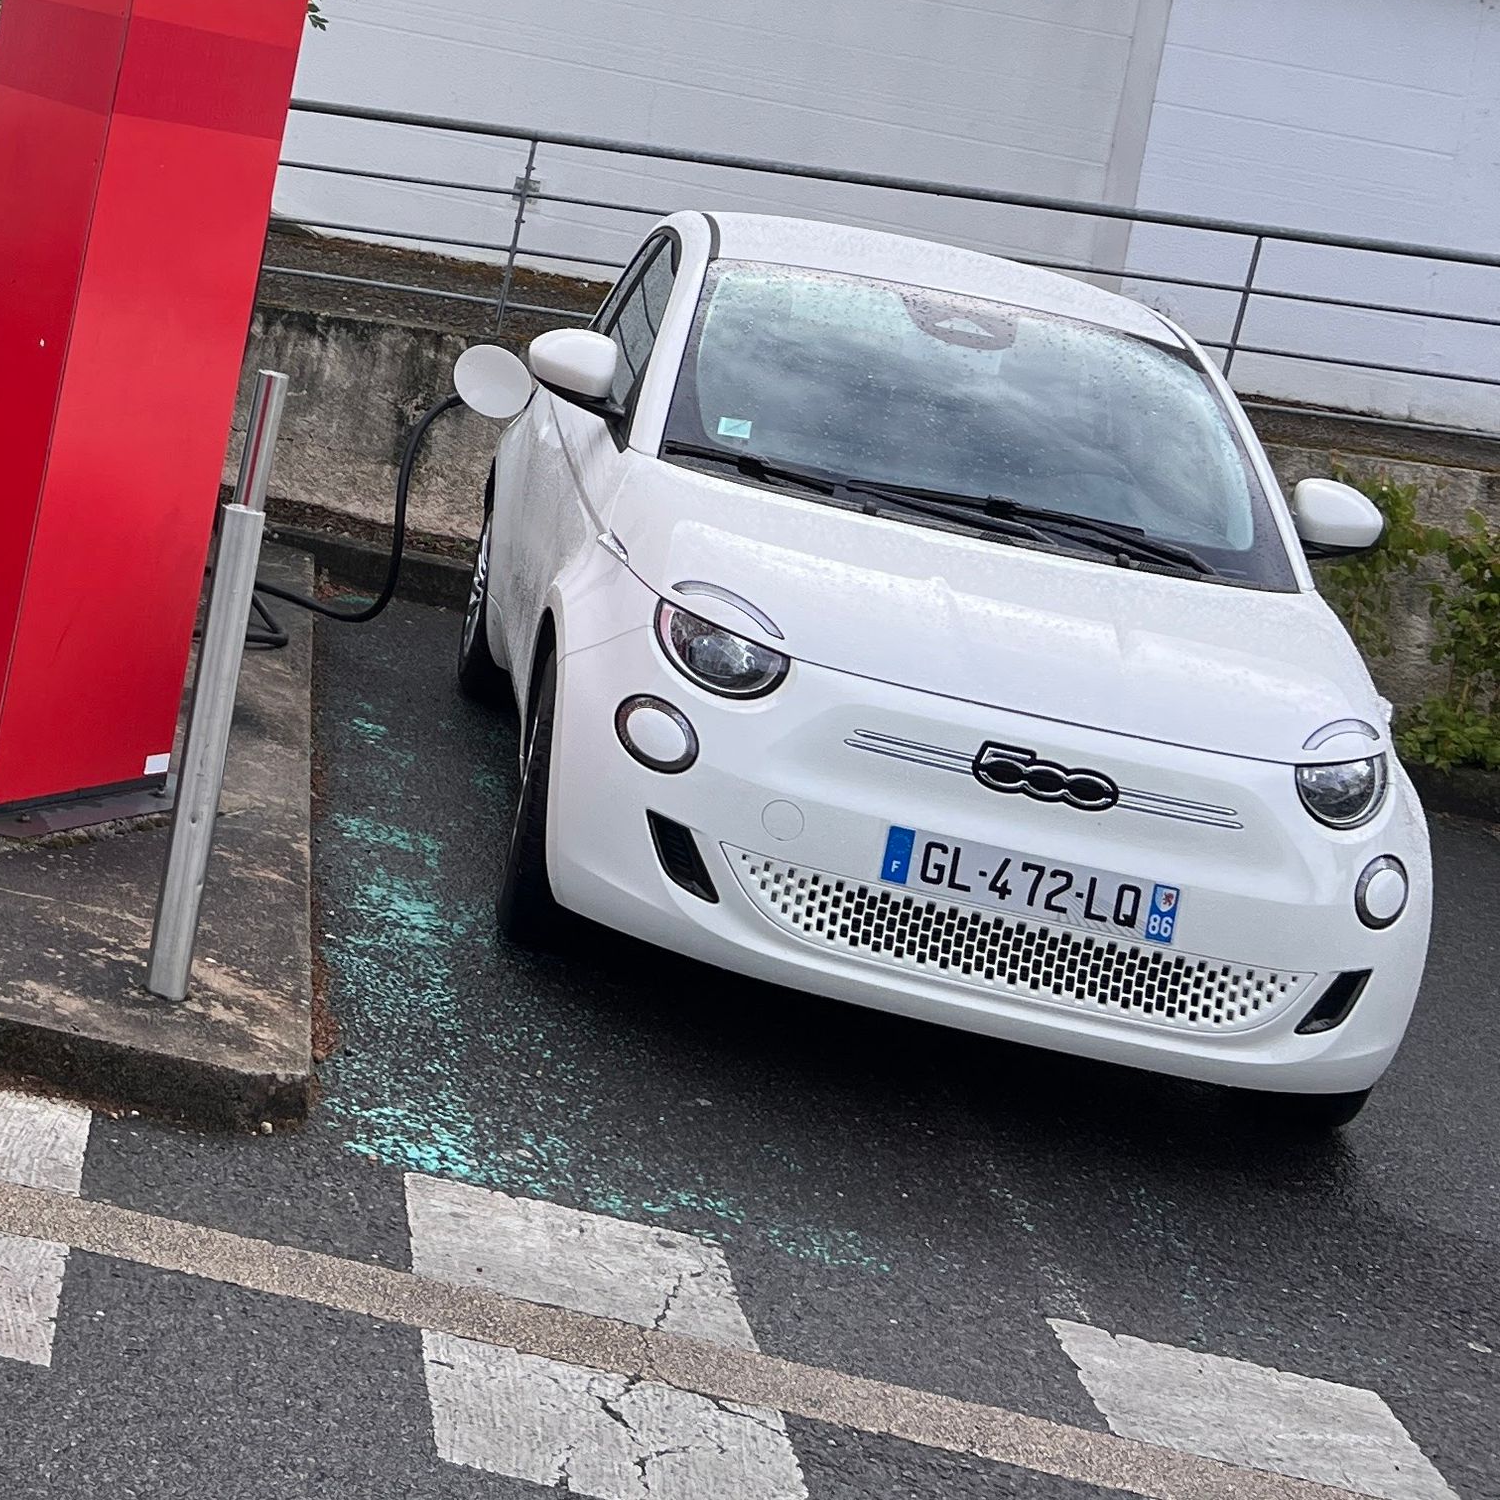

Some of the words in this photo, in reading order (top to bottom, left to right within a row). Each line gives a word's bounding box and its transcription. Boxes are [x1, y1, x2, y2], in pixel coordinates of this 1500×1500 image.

[974, 744, 1116, 808] 500
[890, 860, 901, 874] F
[919, 841, 1142, 929] GL-472-LQ
[1148, 914, 1173, 938] 86
